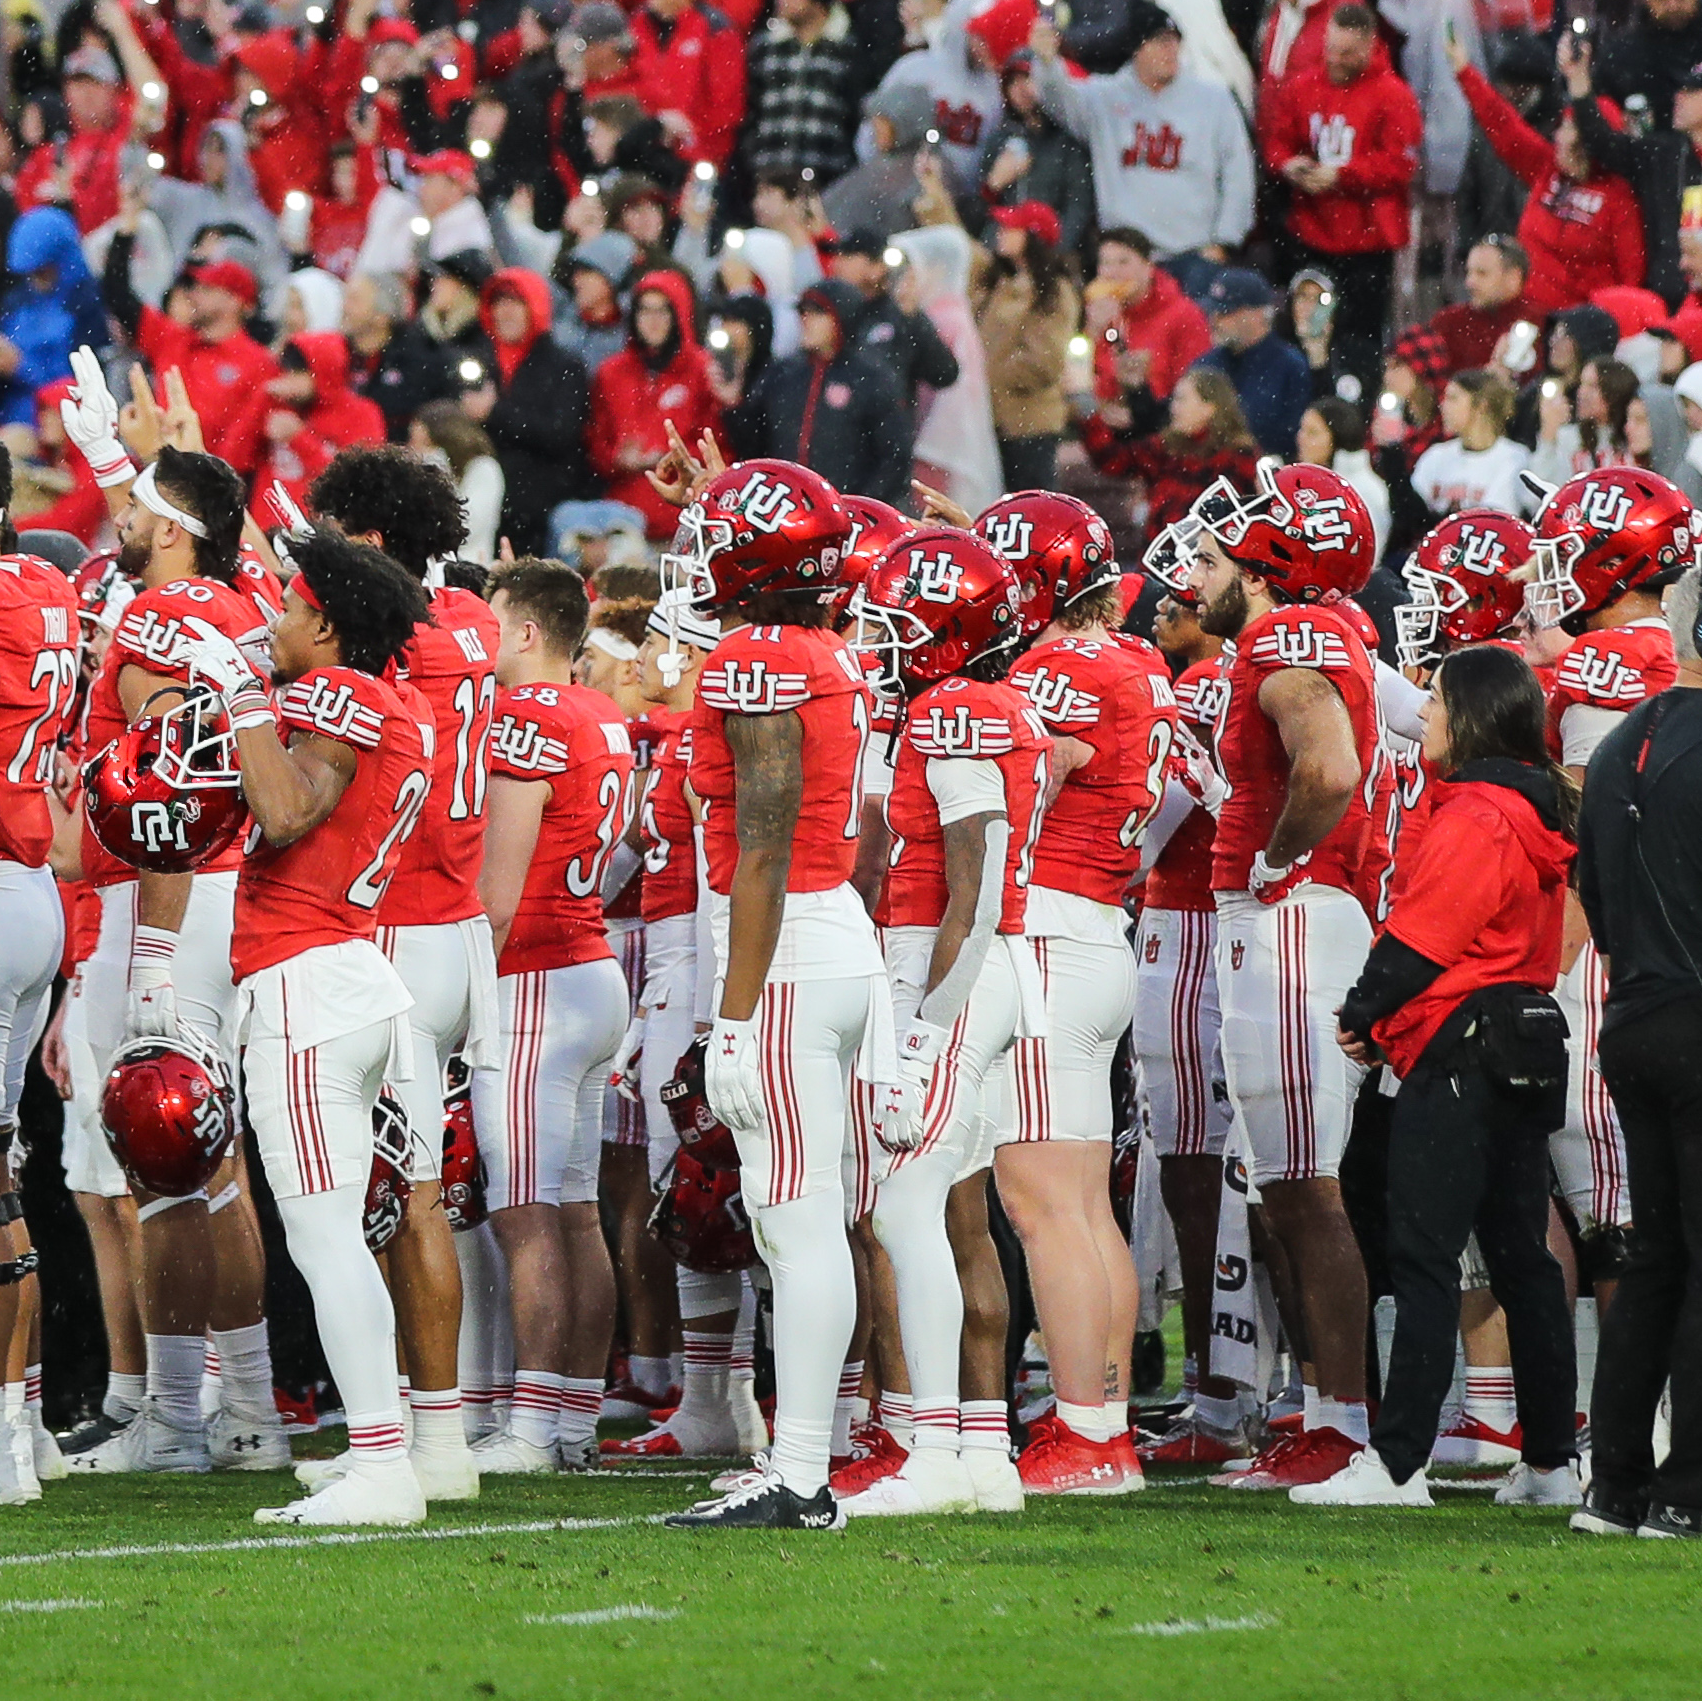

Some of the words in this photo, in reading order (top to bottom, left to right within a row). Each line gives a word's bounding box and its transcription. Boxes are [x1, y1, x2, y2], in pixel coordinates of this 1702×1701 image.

[160, 579, 215, 605] 90
[1053, 637, 1102, 660] 32
[511, 685, 559, 707] 38
[448, 672, 496, 821] 17
